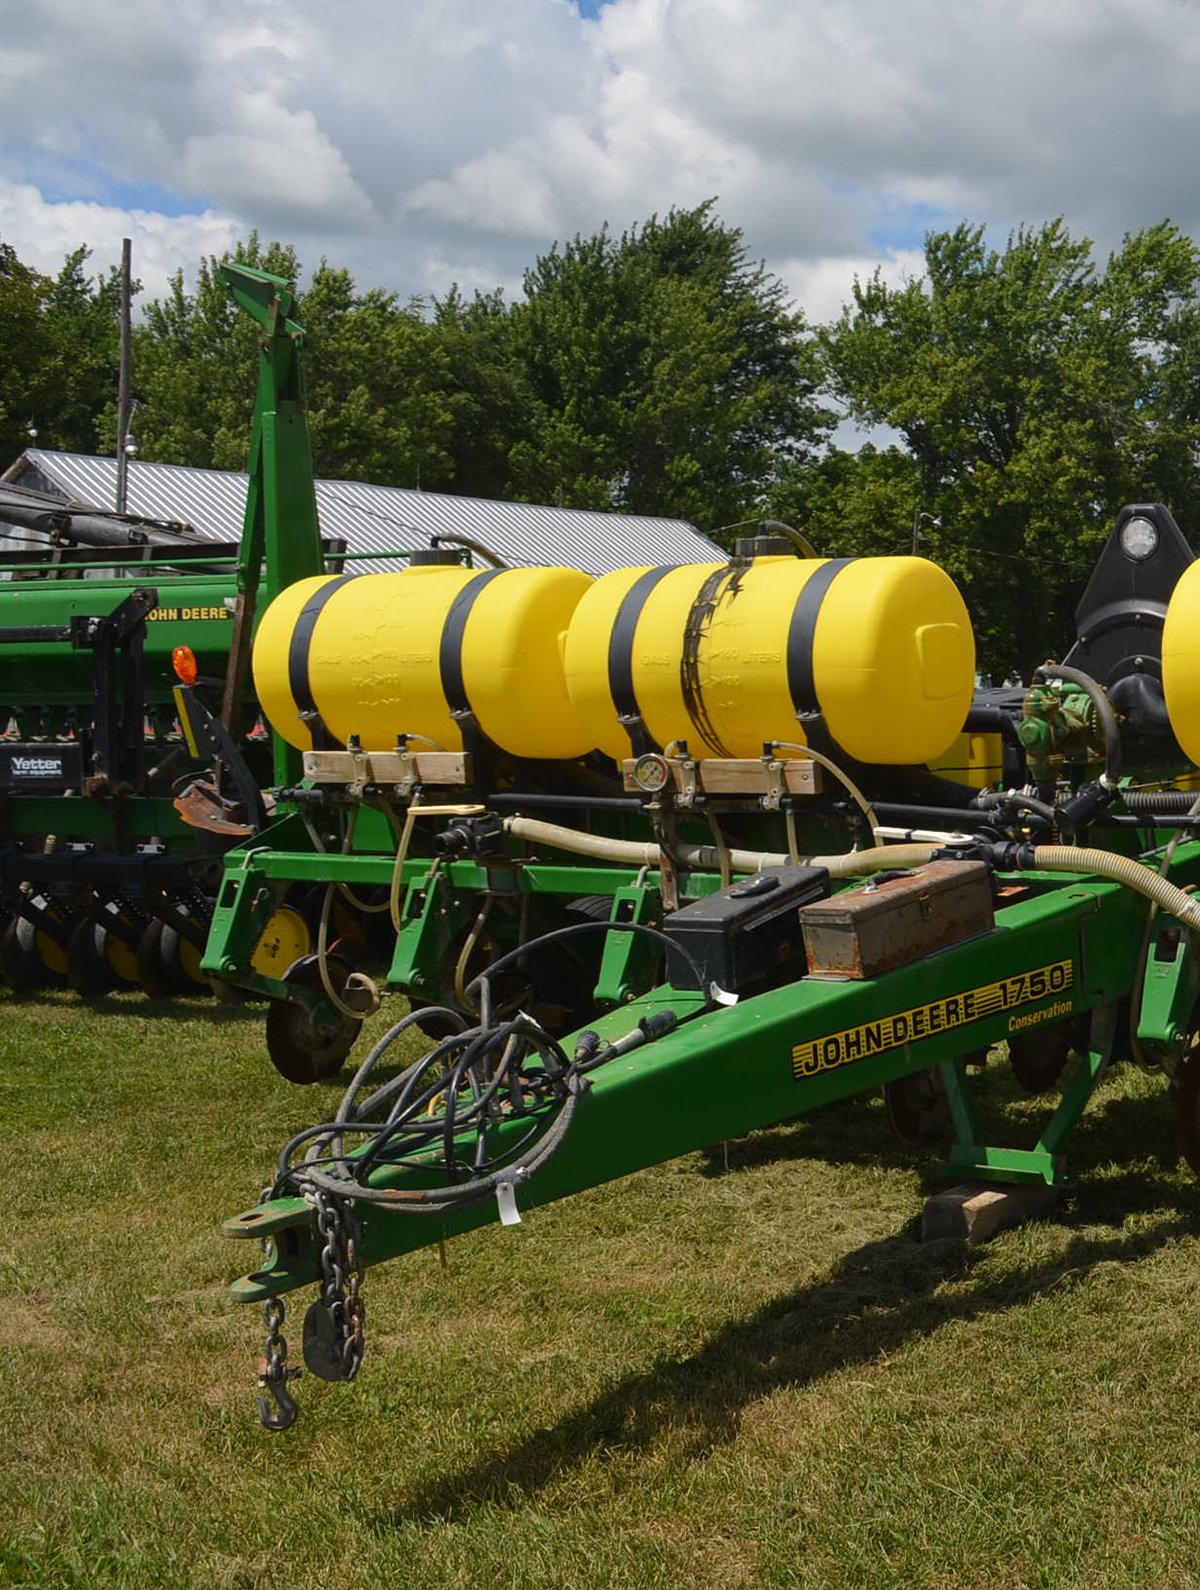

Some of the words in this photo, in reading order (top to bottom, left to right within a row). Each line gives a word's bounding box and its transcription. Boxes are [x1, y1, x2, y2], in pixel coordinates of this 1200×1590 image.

[182, 607, 228, 620] DEERE
[11, 756, 62, 769] Yetter
[802, 1022, 883, 1074] JOHN
[892, 993, 979, 1044] DEERE
[997, 964, 1066, 1009] 1750
[1008, 1000, 1073, 1033] Conservation
